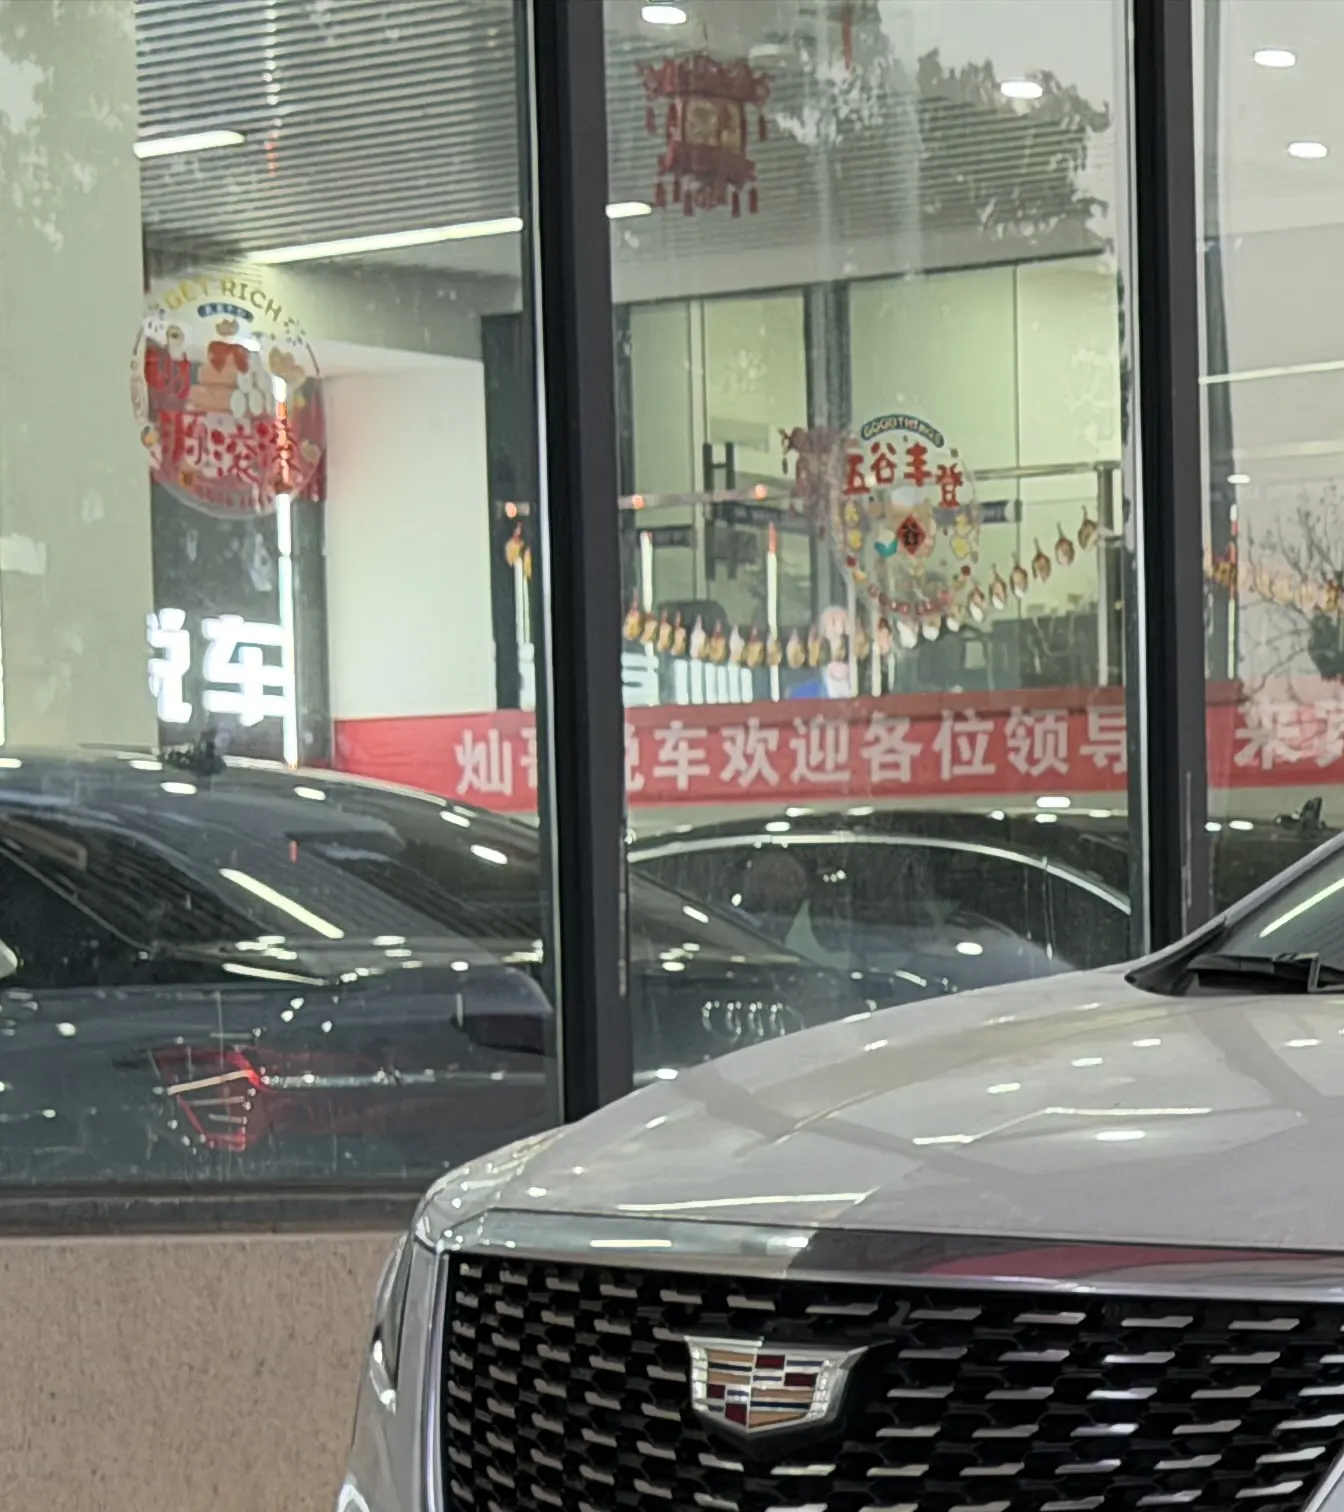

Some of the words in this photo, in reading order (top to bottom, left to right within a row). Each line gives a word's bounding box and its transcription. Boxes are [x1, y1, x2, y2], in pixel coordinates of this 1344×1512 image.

[220, 278, 283, 322] RICH
[842, 441, 964, 509] 五谷丰登
